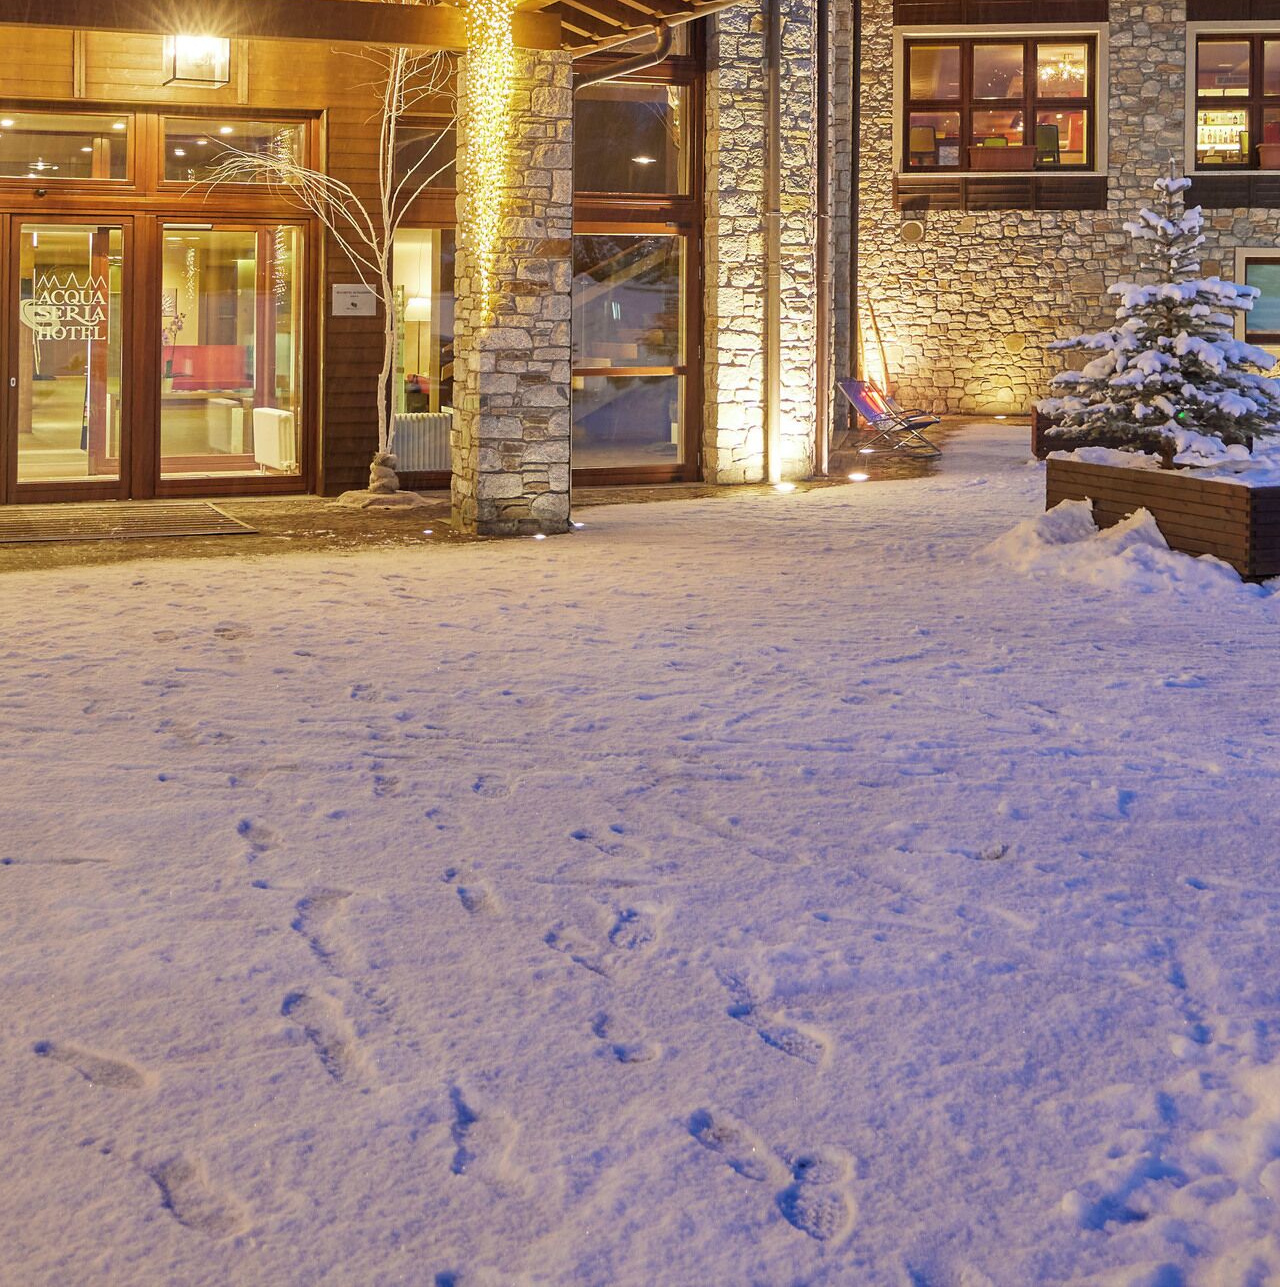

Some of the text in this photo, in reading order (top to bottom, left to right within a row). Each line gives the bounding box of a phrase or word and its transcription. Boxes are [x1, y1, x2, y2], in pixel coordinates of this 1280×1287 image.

[37, 290, 107, 306] ACQUA
[36, 306, 107, 326] SERIA
[37, 326, 107, 341] HOTEL
